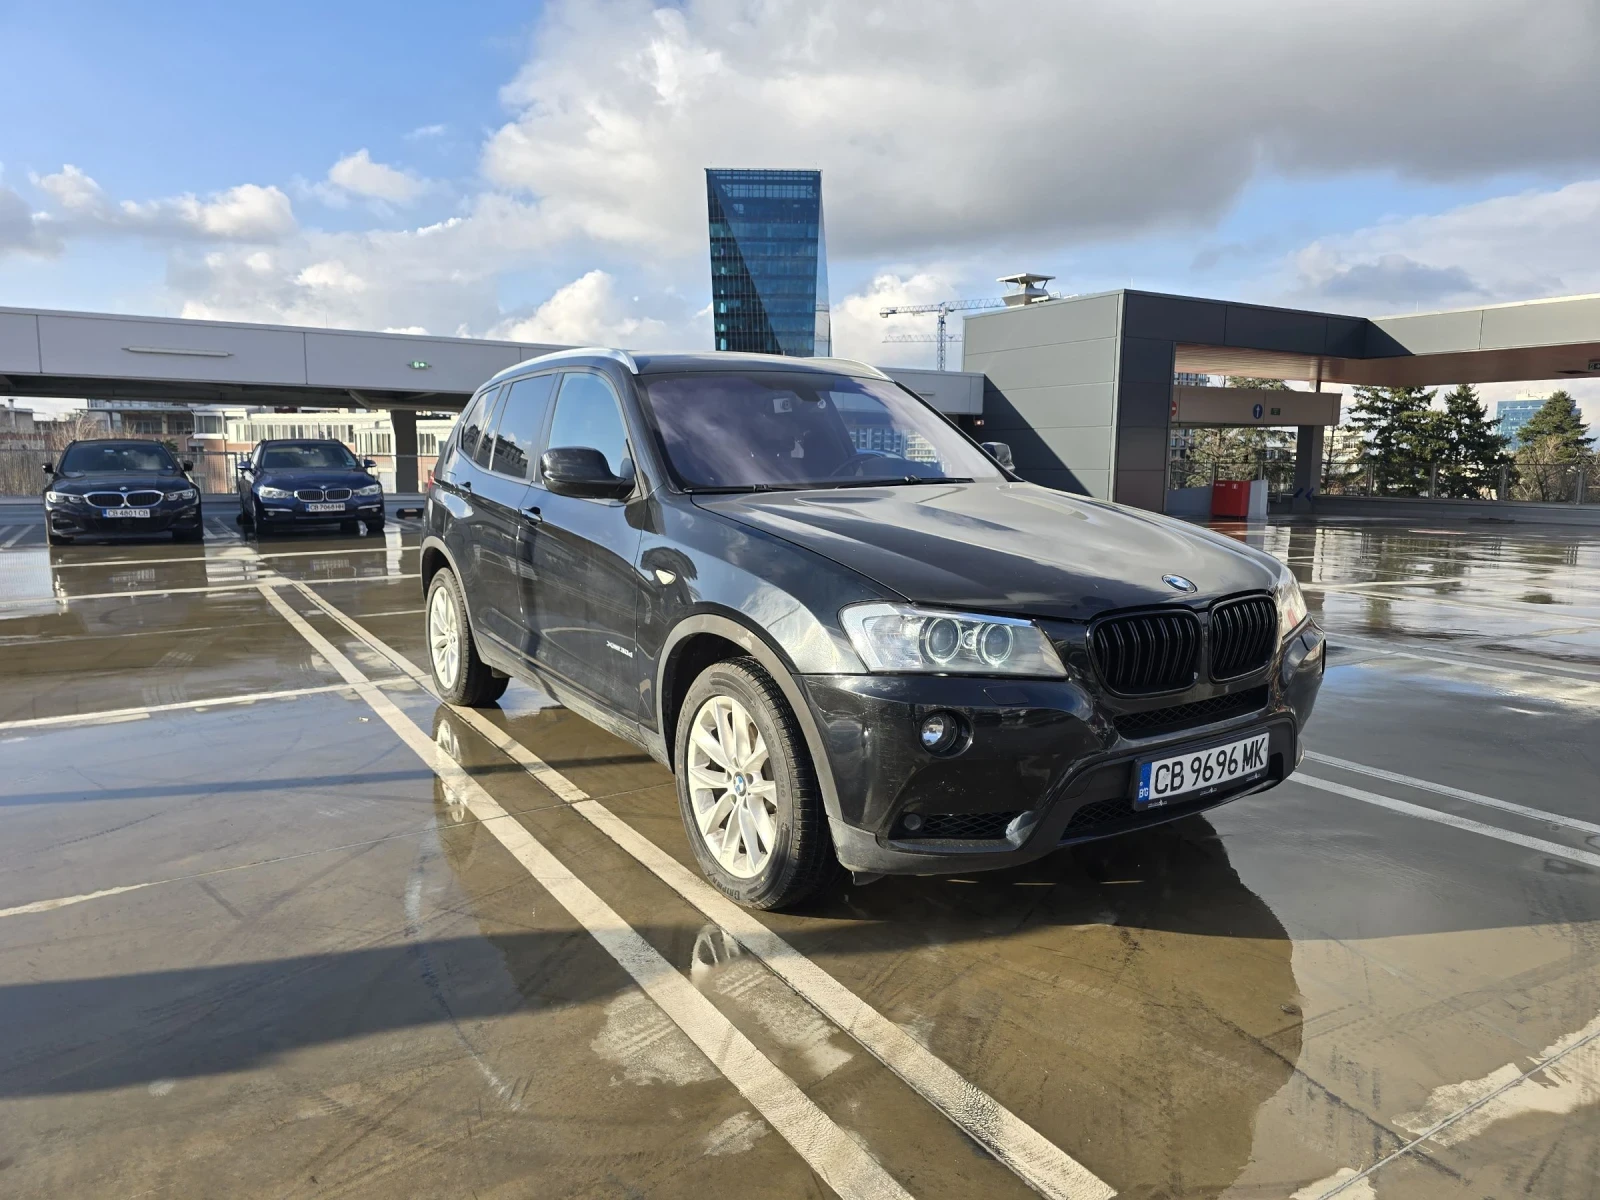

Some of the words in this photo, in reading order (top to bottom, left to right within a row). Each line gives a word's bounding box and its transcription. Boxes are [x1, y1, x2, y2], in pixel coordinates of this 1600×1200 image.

[1154, 760, 1185, 794] CB
[1190, 746, 1238, 787] 9696
[1242, 737, 1266, 772] MK
